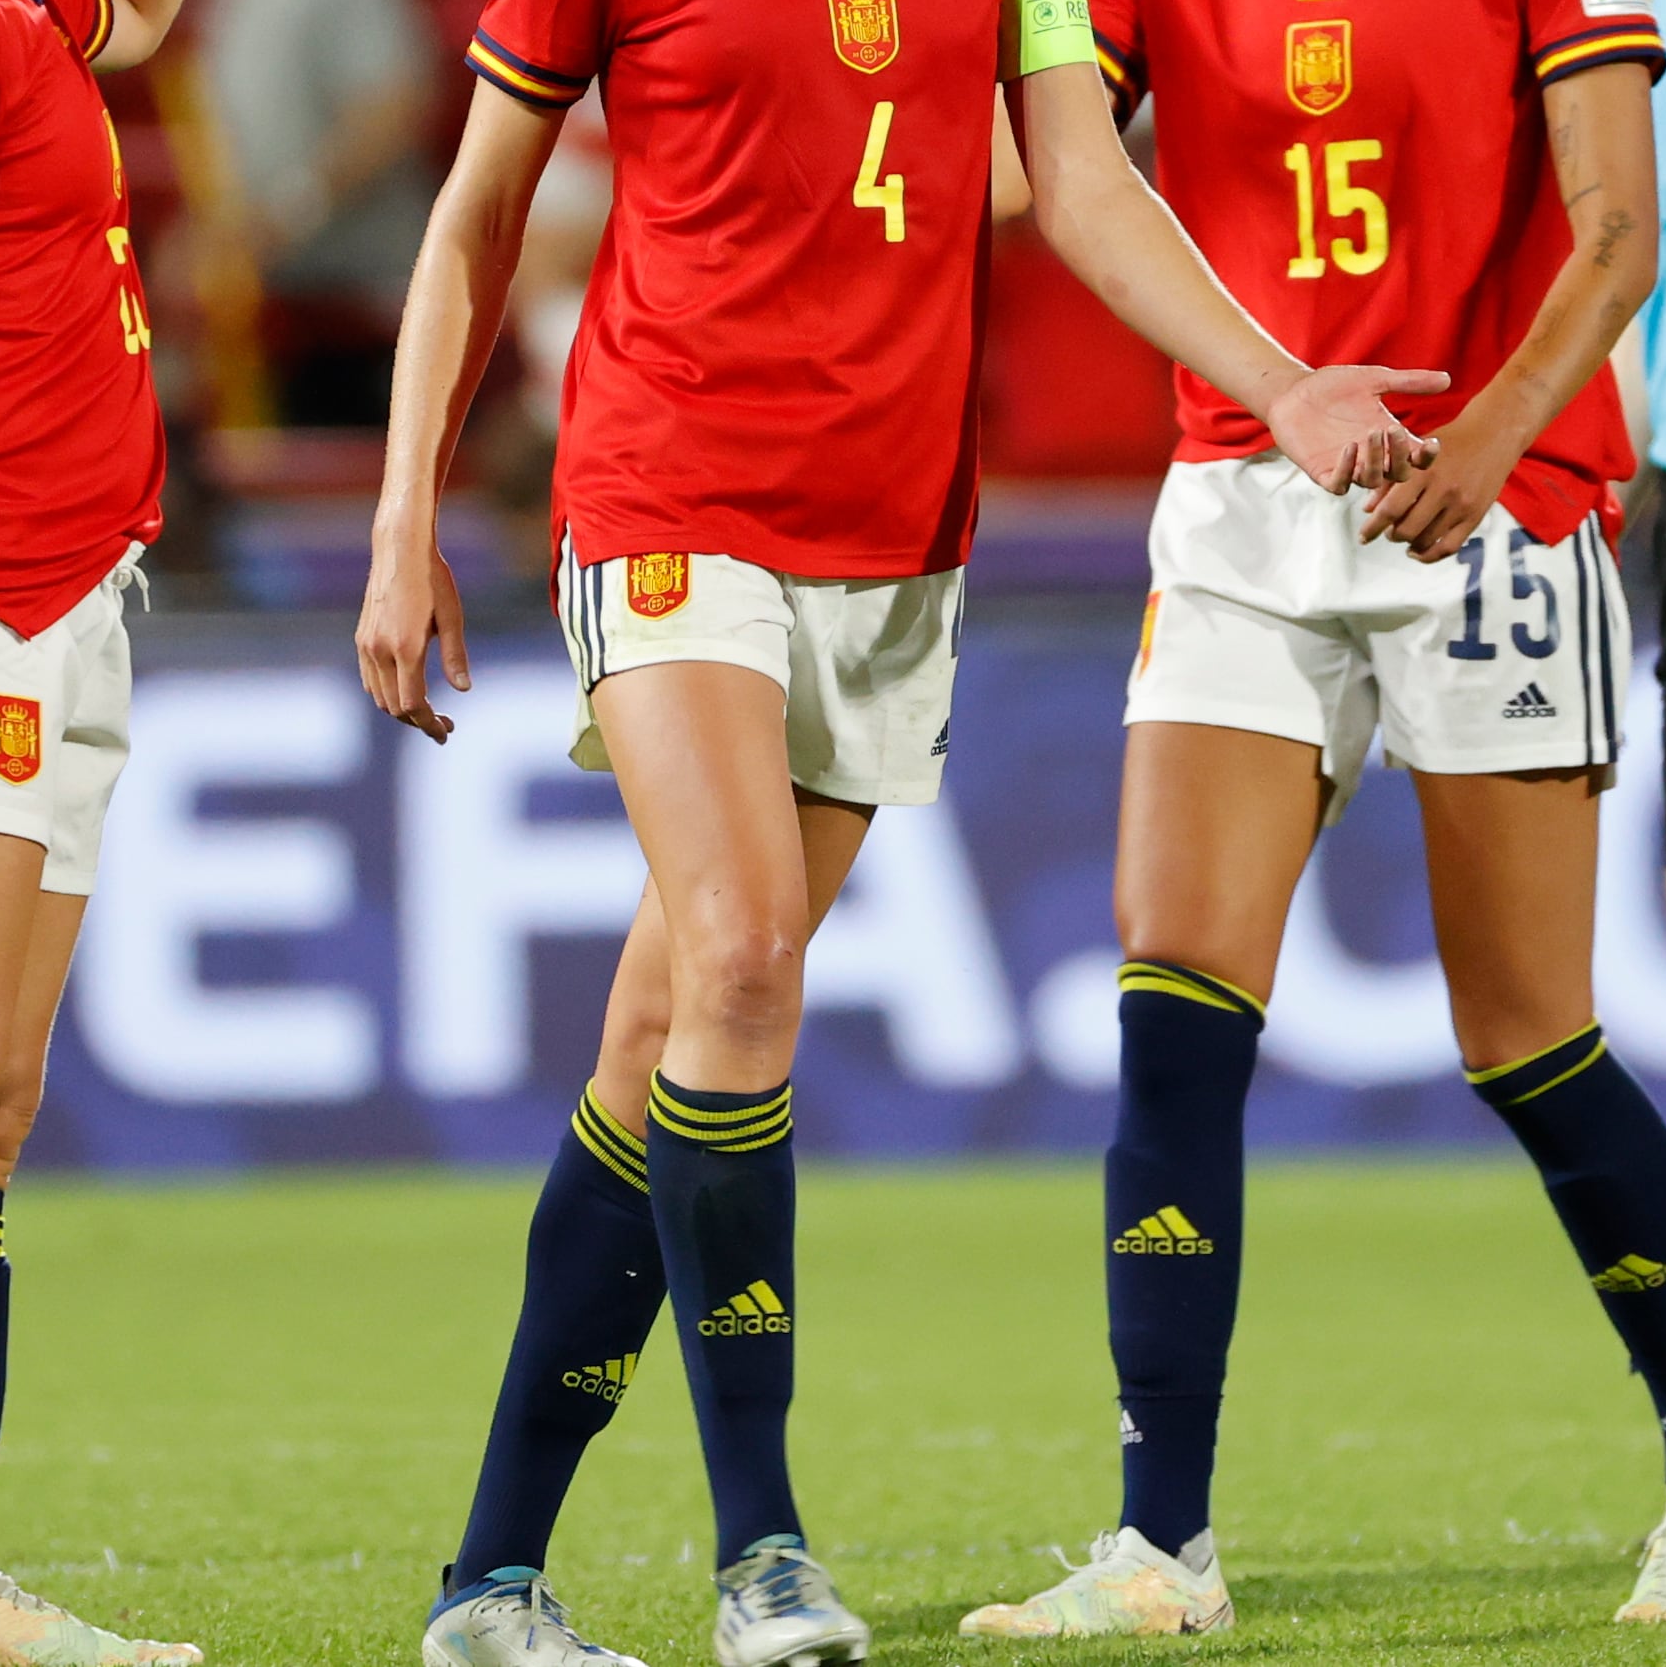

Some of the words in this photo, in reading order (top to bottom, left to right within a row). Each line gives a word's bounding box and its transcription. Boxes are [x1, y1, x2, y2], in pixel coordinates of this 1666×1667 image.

[853, 100, 906, 243] 4
[1283, 139, 1390, 280] 15
[1448, 527, 1561, 660] 15
[1502, 704, 1558, 719] adidas
[1113, 1235, 1214, 1255] adidas
[697, 1313, 791, 1337] adidas
